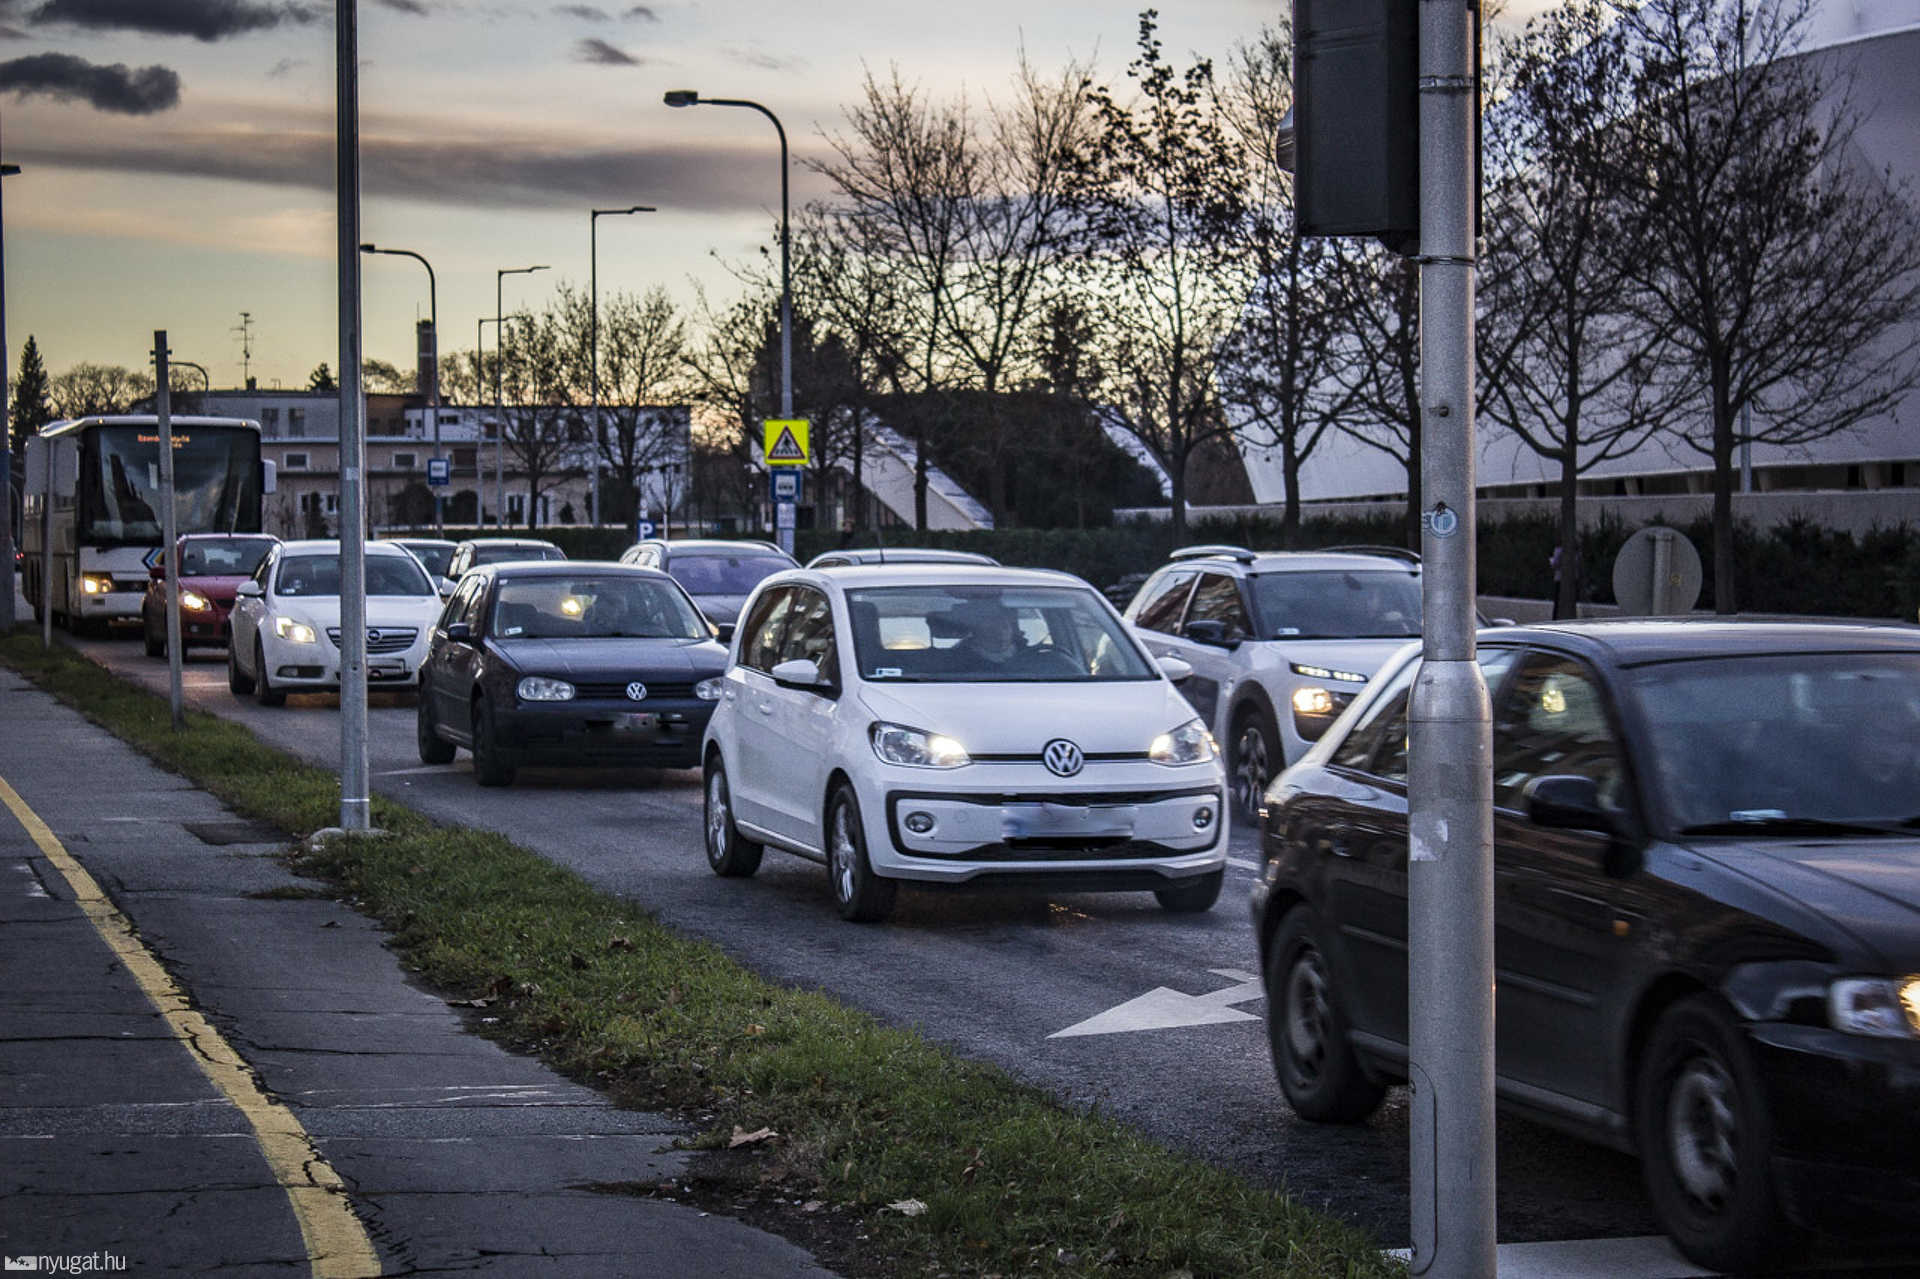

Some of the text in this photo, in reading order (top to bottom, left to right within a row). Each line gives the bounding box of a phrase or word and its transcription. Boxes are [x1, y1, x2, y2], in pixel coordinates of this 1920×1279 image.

[640, 522, 653, 539] P
[627, 682, 647, 700] VW
[1044, 740, 1082, 776] VW
